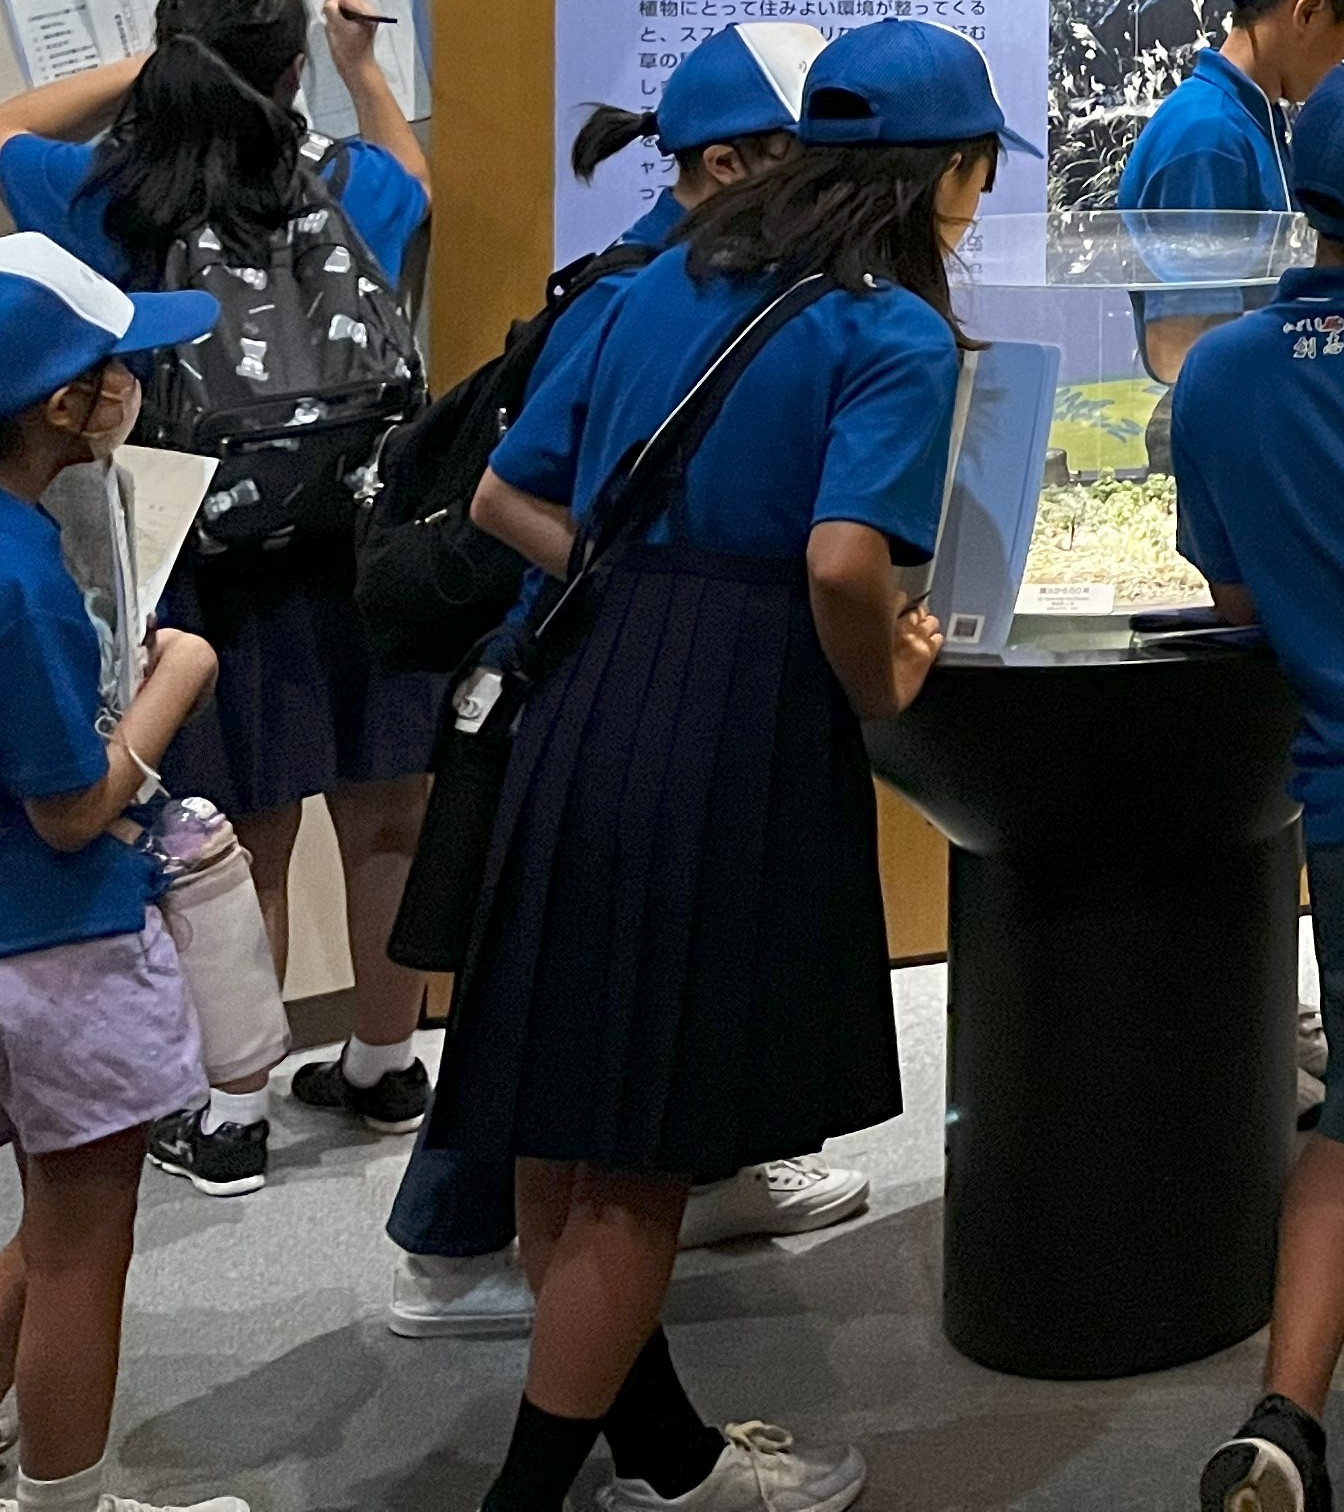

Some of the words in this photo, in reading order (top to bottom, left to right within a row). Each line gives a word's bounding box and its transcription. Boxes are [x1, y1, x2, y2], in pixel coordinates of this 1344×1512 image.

[639, 0, 986, 17] 植物にとって住みよい環境が整ってくる
